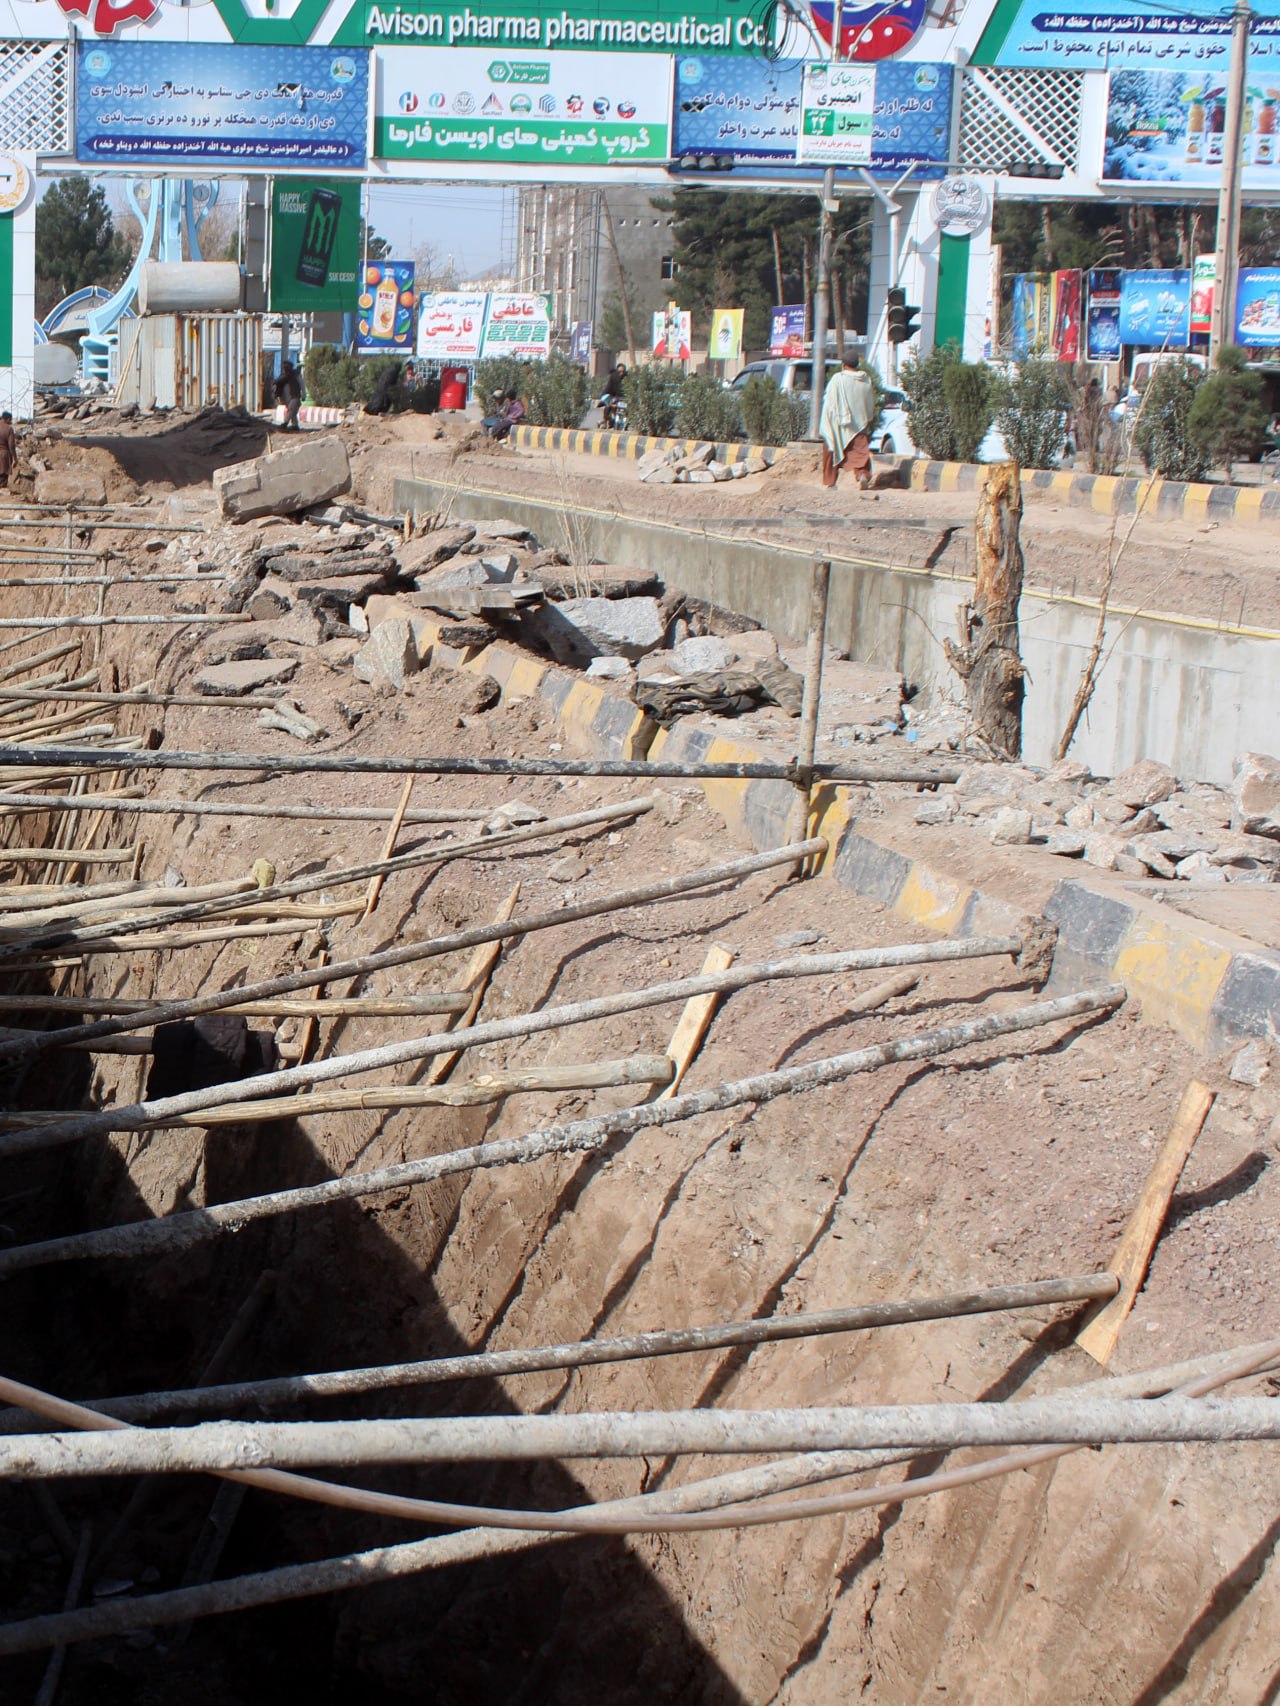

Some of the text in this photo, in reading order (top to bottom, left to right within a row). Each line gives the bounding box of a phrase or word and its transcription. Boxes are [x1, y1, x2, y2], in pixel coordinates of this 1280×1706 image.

[365, 7, 442, 36] Avison
[448, 9, 540, 43] pharma
[545, 10, 731, 46] pharmaceutical
[1053, 39, 1093, 57] محفوظ
[388, 120, 650, 155] گروپ کمپنی های اویسن فارما
[279, 192, 301, 202] HAPPY
[279, 203, 307, 214] MASSIVE
[328, 272, 355, 282] SUCCESS!
[493, 303, 534, 319] عاطفی
